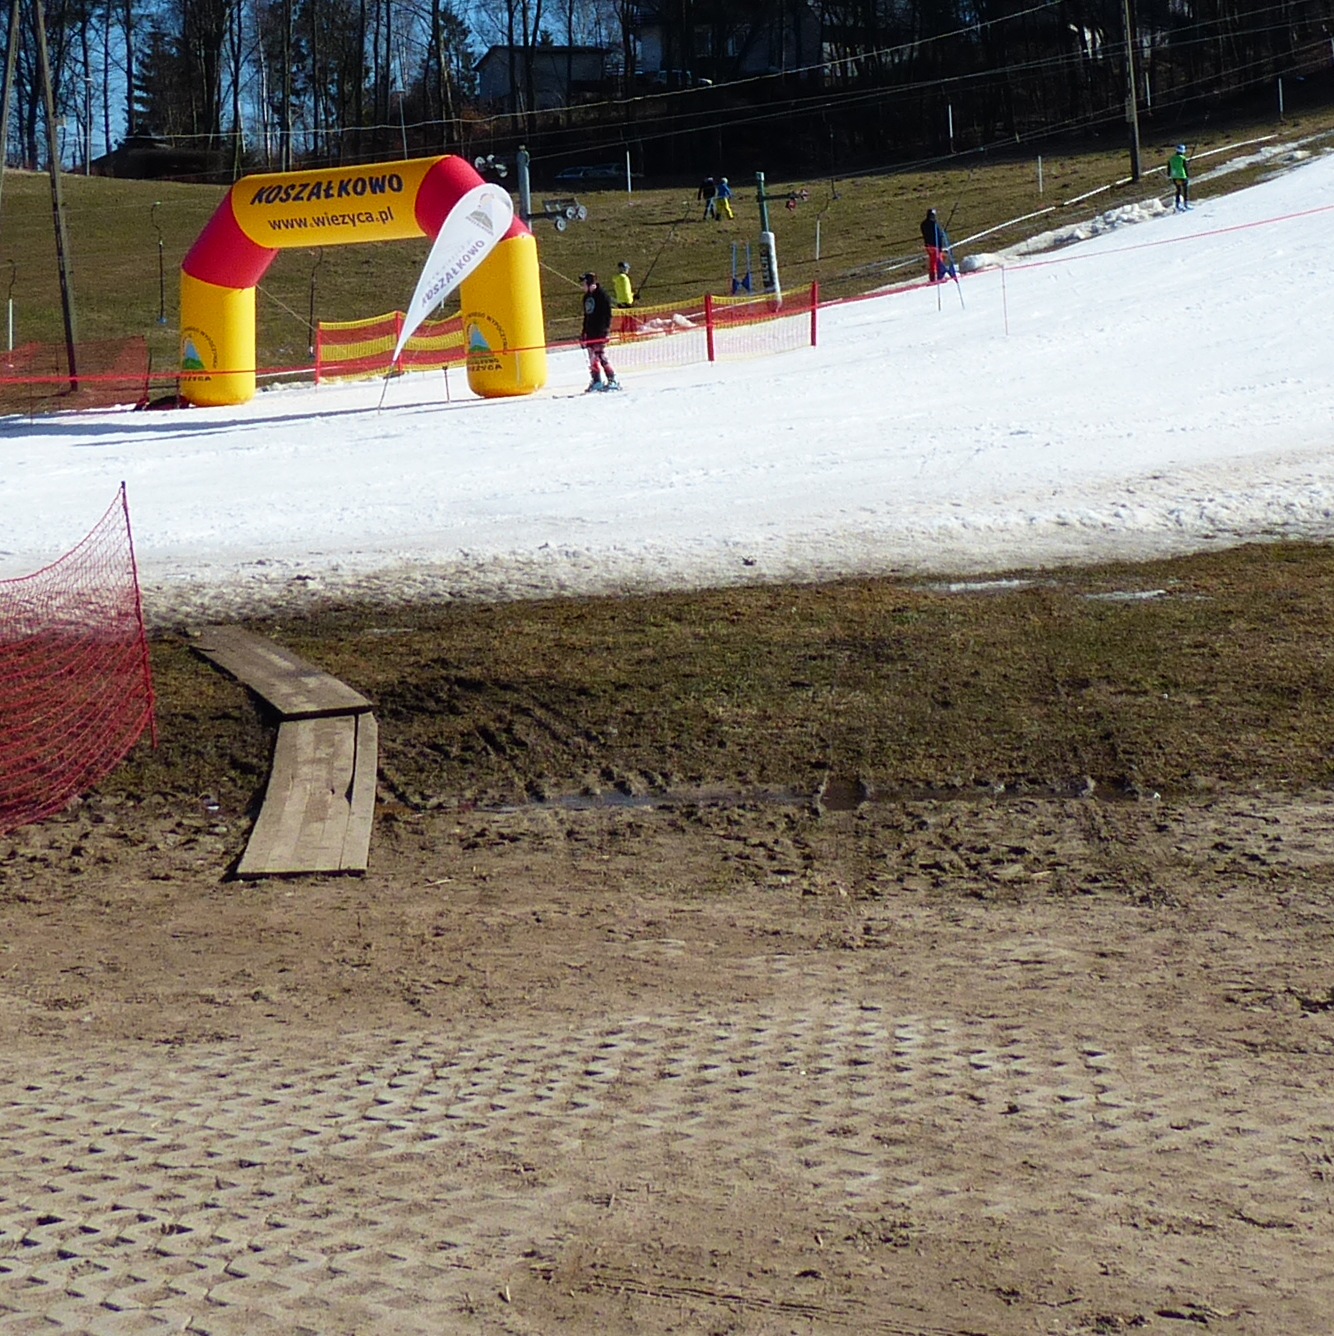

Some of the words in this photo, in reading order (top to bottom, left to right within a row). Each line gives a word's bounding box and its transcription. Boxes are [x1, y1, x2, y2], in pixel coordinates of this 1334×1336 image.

[250, 173, 404, 206] KOSZAŁKOWO
[268, 206, 395, 231] www.wiezyca.pl
[421, 239, 486, 307] KOSZAŁKOWO
